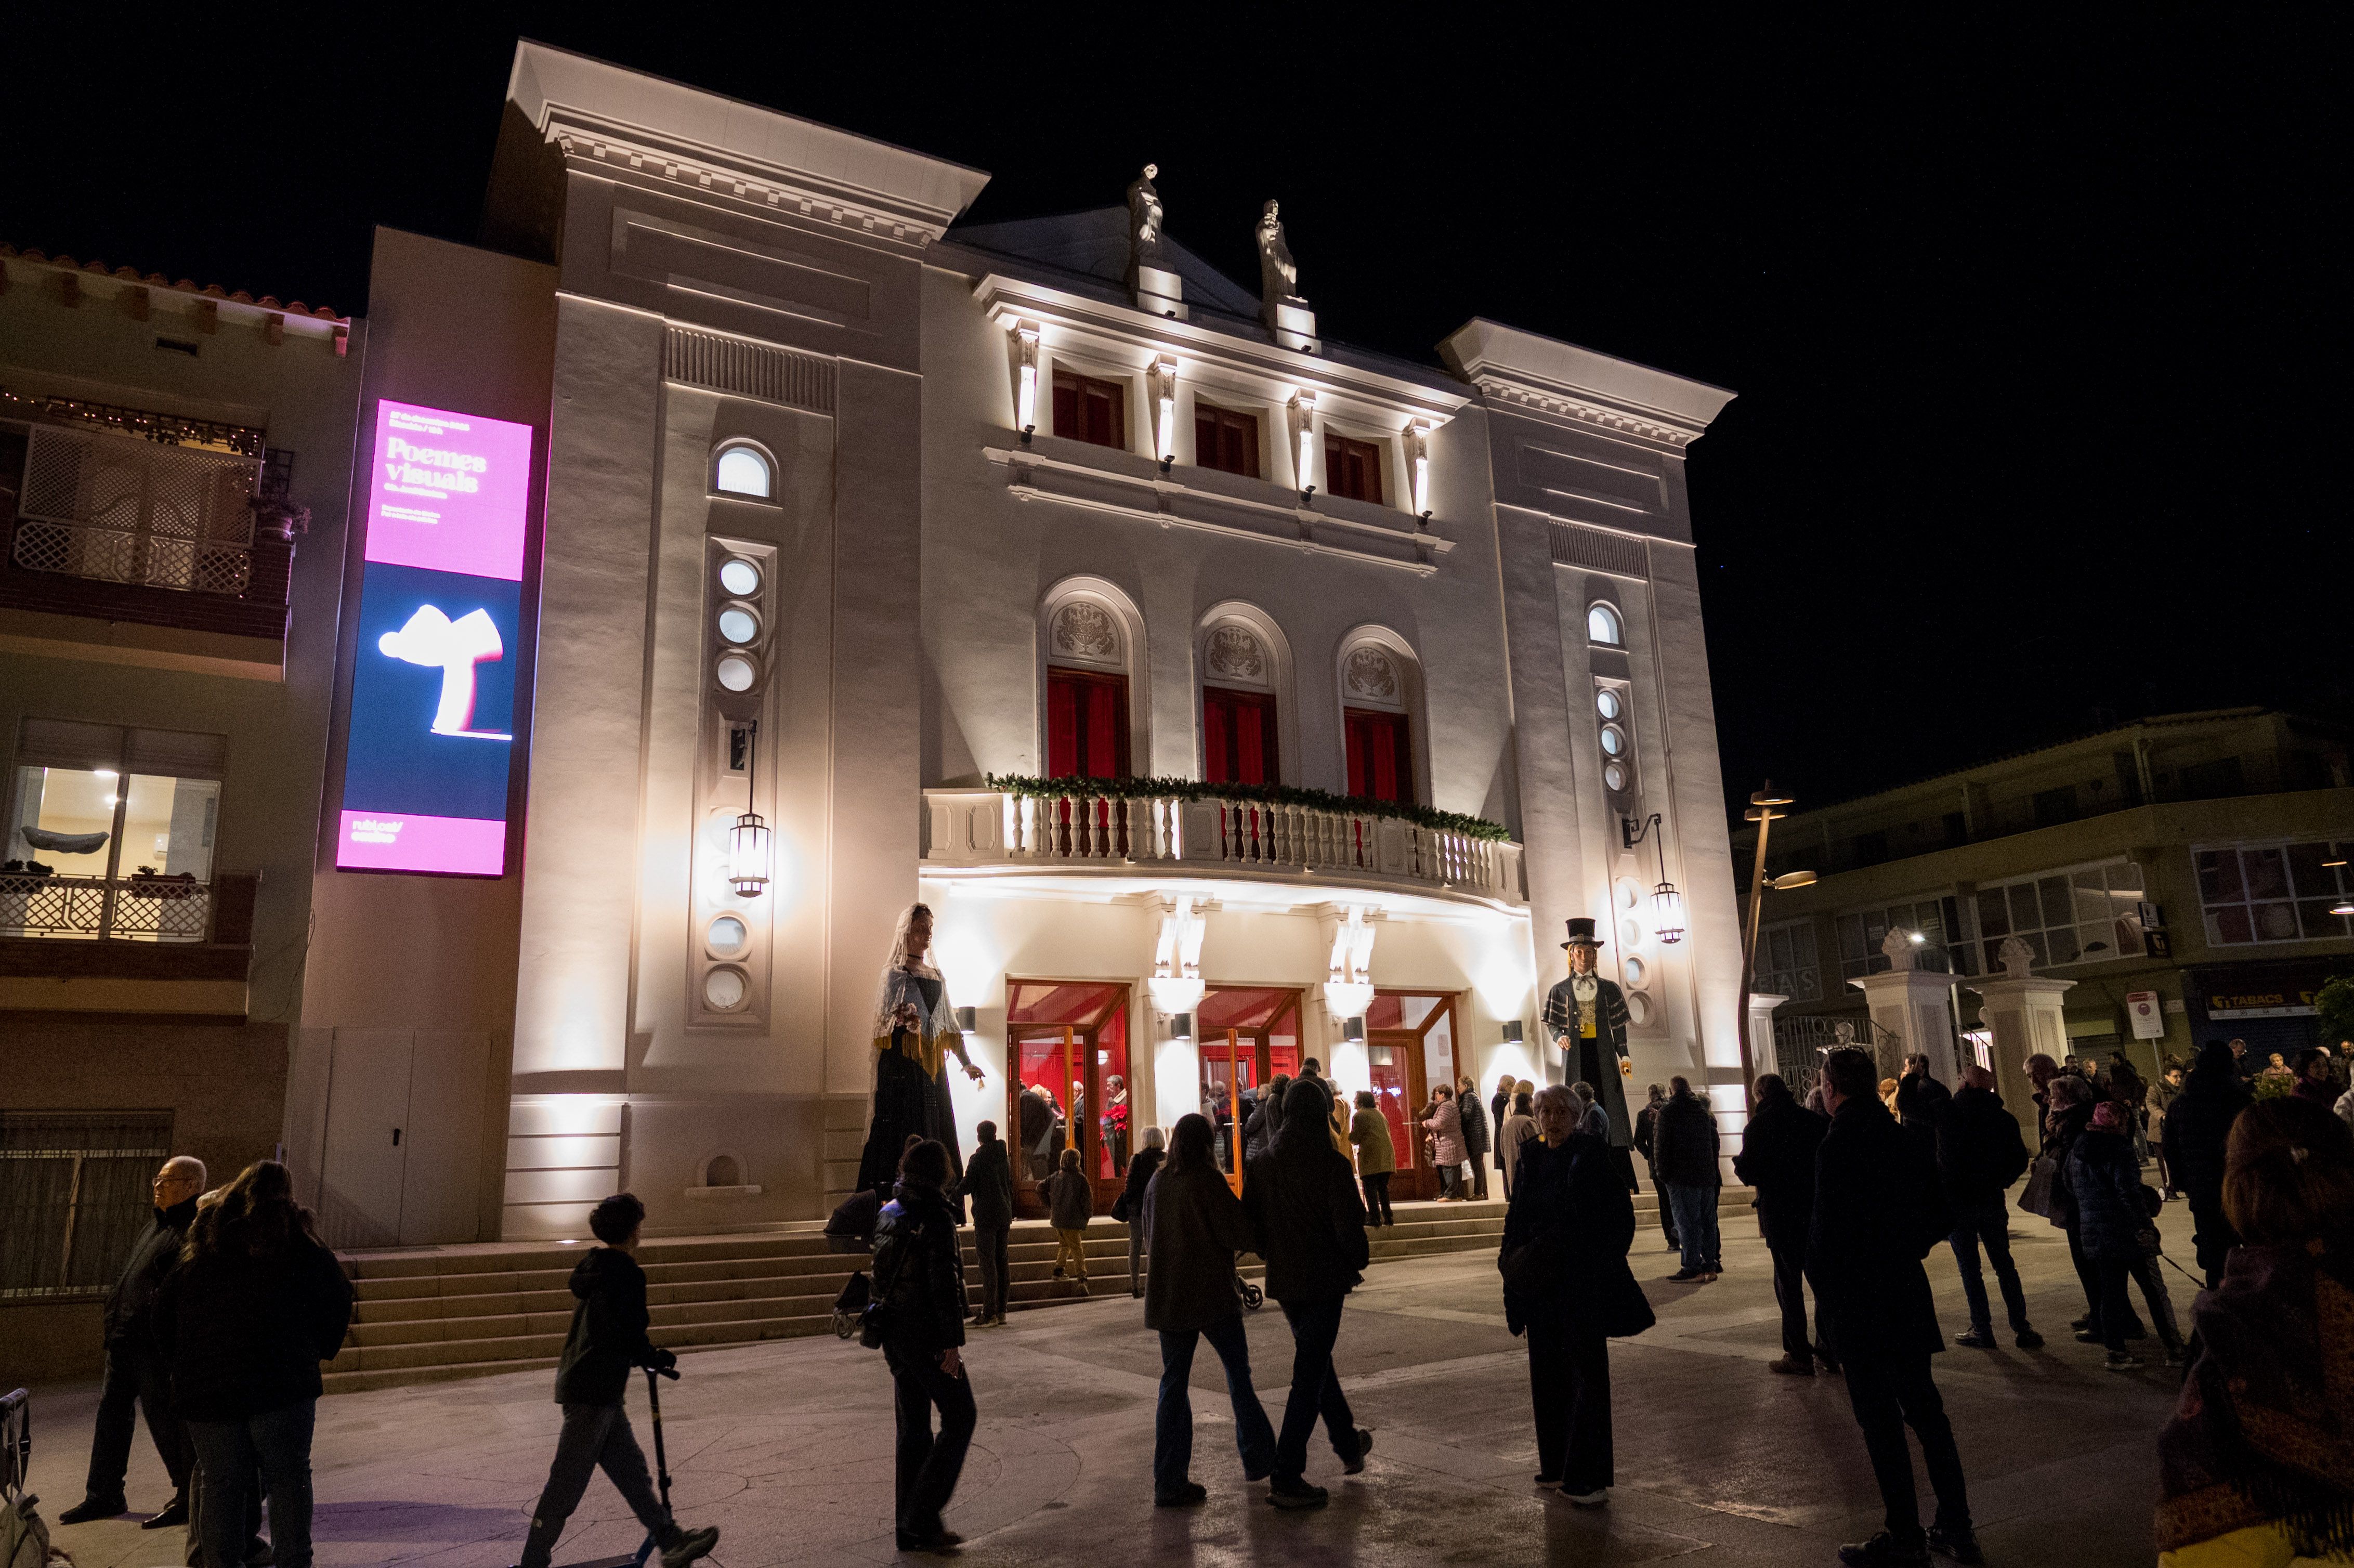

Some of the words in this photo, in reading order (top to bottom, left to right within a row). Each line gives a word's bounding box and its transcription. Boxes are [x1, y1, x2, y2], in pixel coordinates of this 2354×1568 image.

[387, 437, 487, 473] Poemes
[385, 463, 478, 493] visuals
[2231, 994, 2284, 1007] TABACS
